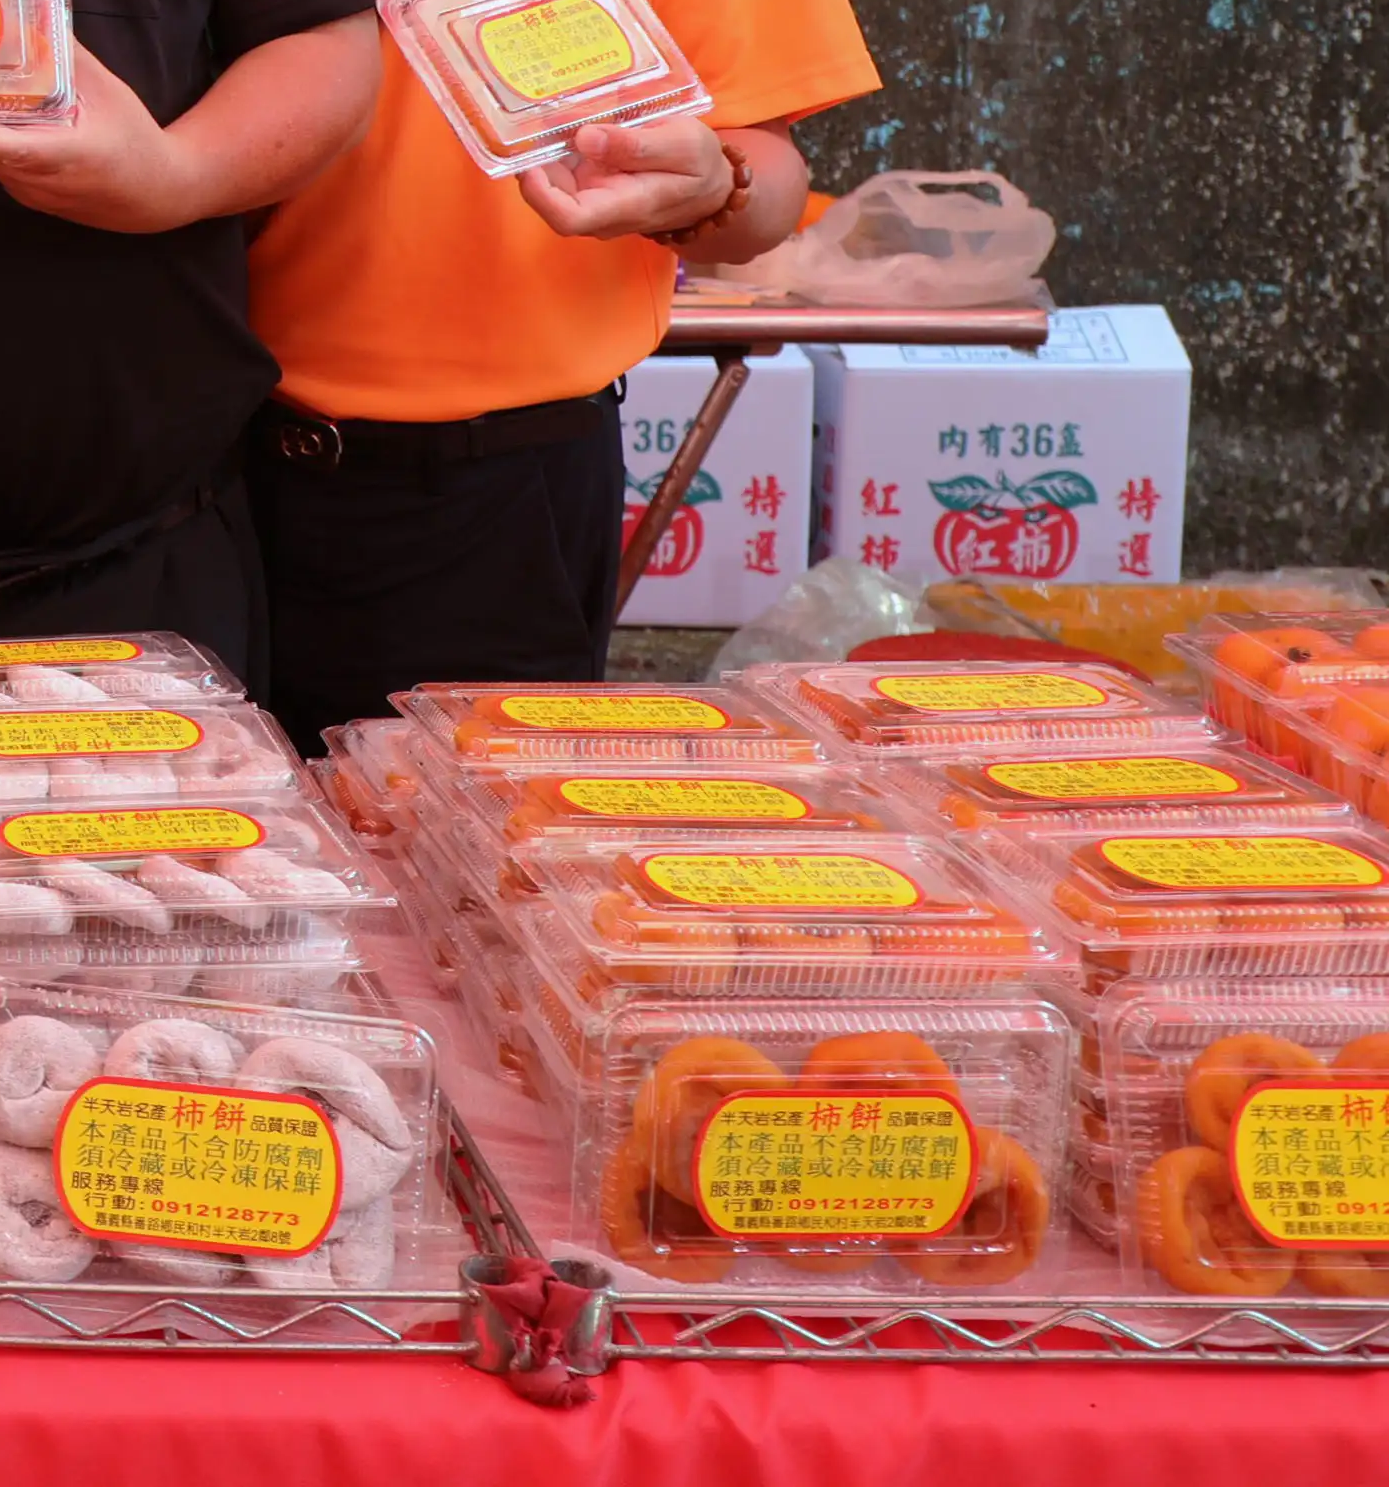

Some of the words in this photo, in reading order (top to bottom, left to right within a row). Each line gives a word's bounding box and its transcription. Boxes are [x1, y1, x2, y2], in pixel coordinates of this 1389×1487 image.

[860, 477, 901, 573] 紅柿
[1118, 476, 1162, 577] 特選
[955, 525, 1053, 576] 紅柿
[83, 1096, 167, 1122] 半天岩名產
[171, 1096, 247, 1136] 柿餅
[250, 1115, 319, 1138] 品質保證
[720, 1111, 803, 1127] 半天岩名產
[807, 1101, 883, 1133] 柿餅
[887, 1111, 954, 1127] 品質保證
[1250, 1105, 1335, 1122] 半天岩名產
[1339, 1093, 1389, 1128] 柿
[79, 1119, 323, 1171] 本產品不含防腐劑
[717, 1132, 958, 1157] 本產品不含防腐劑
[75, 1144, 321, 1196] 須冷藏或冷凍保鮮
[714, 1155, 957, 1181] 須冷藏或冷凍保鮮
[1254, 1152, 1389, 1180] 須冷藏或
[71, 1170, 165, 1196] 服務專線
[710, 1180, 802, 1197] 服務專線
[1253, 1180, 1347, 1200] 服務專線
[83, 1192, 145, 1211] 行動:
[151, 1199, 300, 1226] 0912128773
[723, 1198, 783, 1213] 行動:
[788, 1198, 935, 1210] 0912128773
